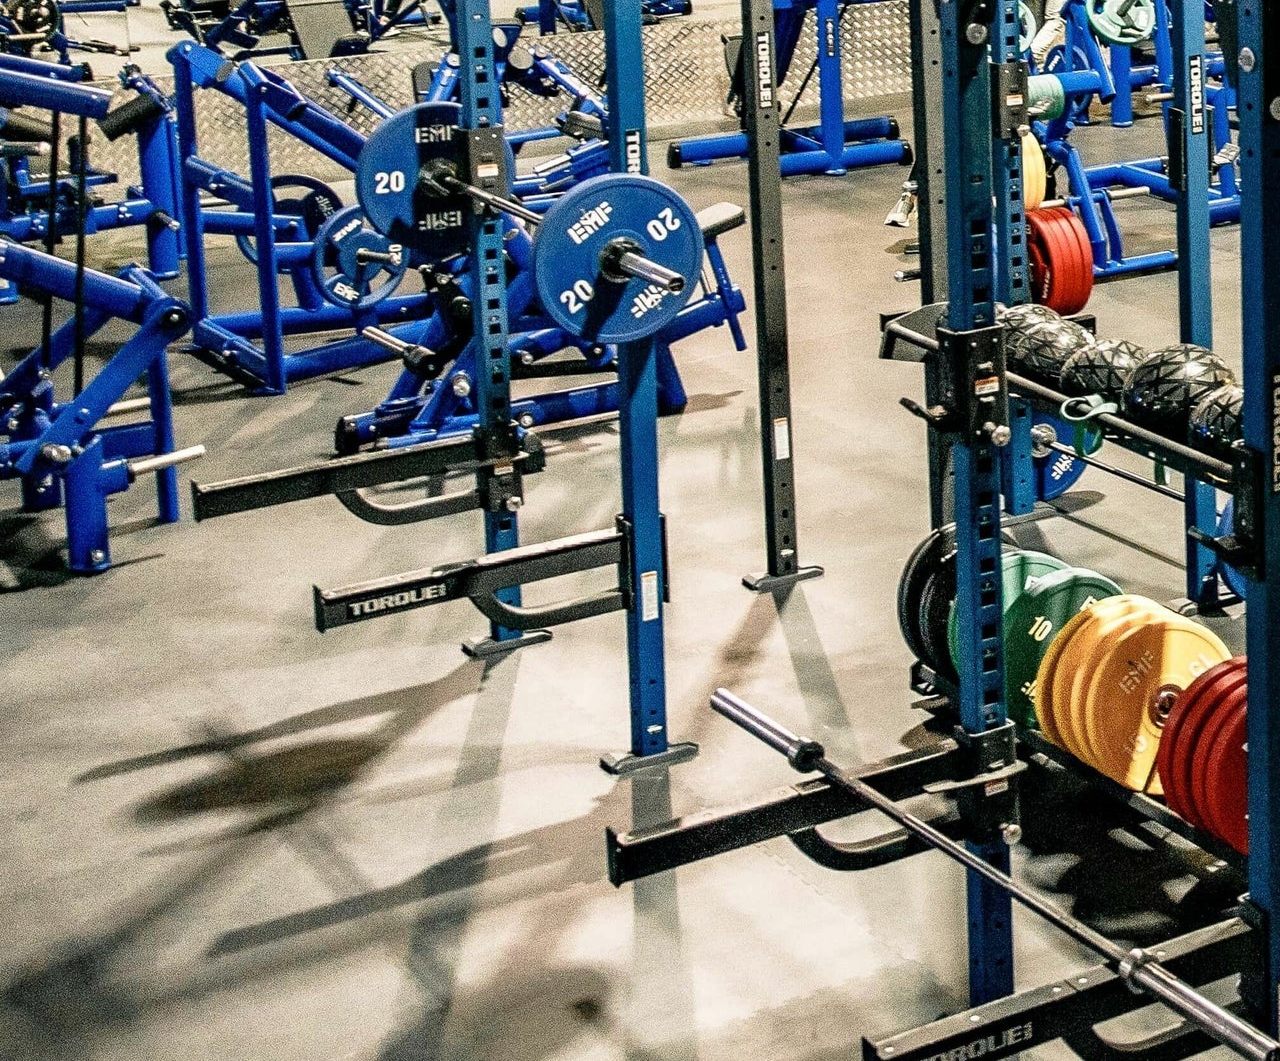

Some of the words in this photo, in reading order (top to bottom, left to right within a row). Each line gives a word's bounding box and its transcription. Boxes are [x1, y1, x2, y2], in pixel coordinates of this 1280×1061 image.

[757, 32, 772, 102] TORQUE
[1190, 56, 1203, 127] TORQUE
[626, 131, 641, 175] TOR
[374, 170, 406, 195] 20
[566, 201, 613, 244] EMF
[646, 207, 681, 241] 20
[559, 279, 594, 314] 20
[349, 585, 440, 616] TORQUE
[1028, 616, 1053, 642] 10
